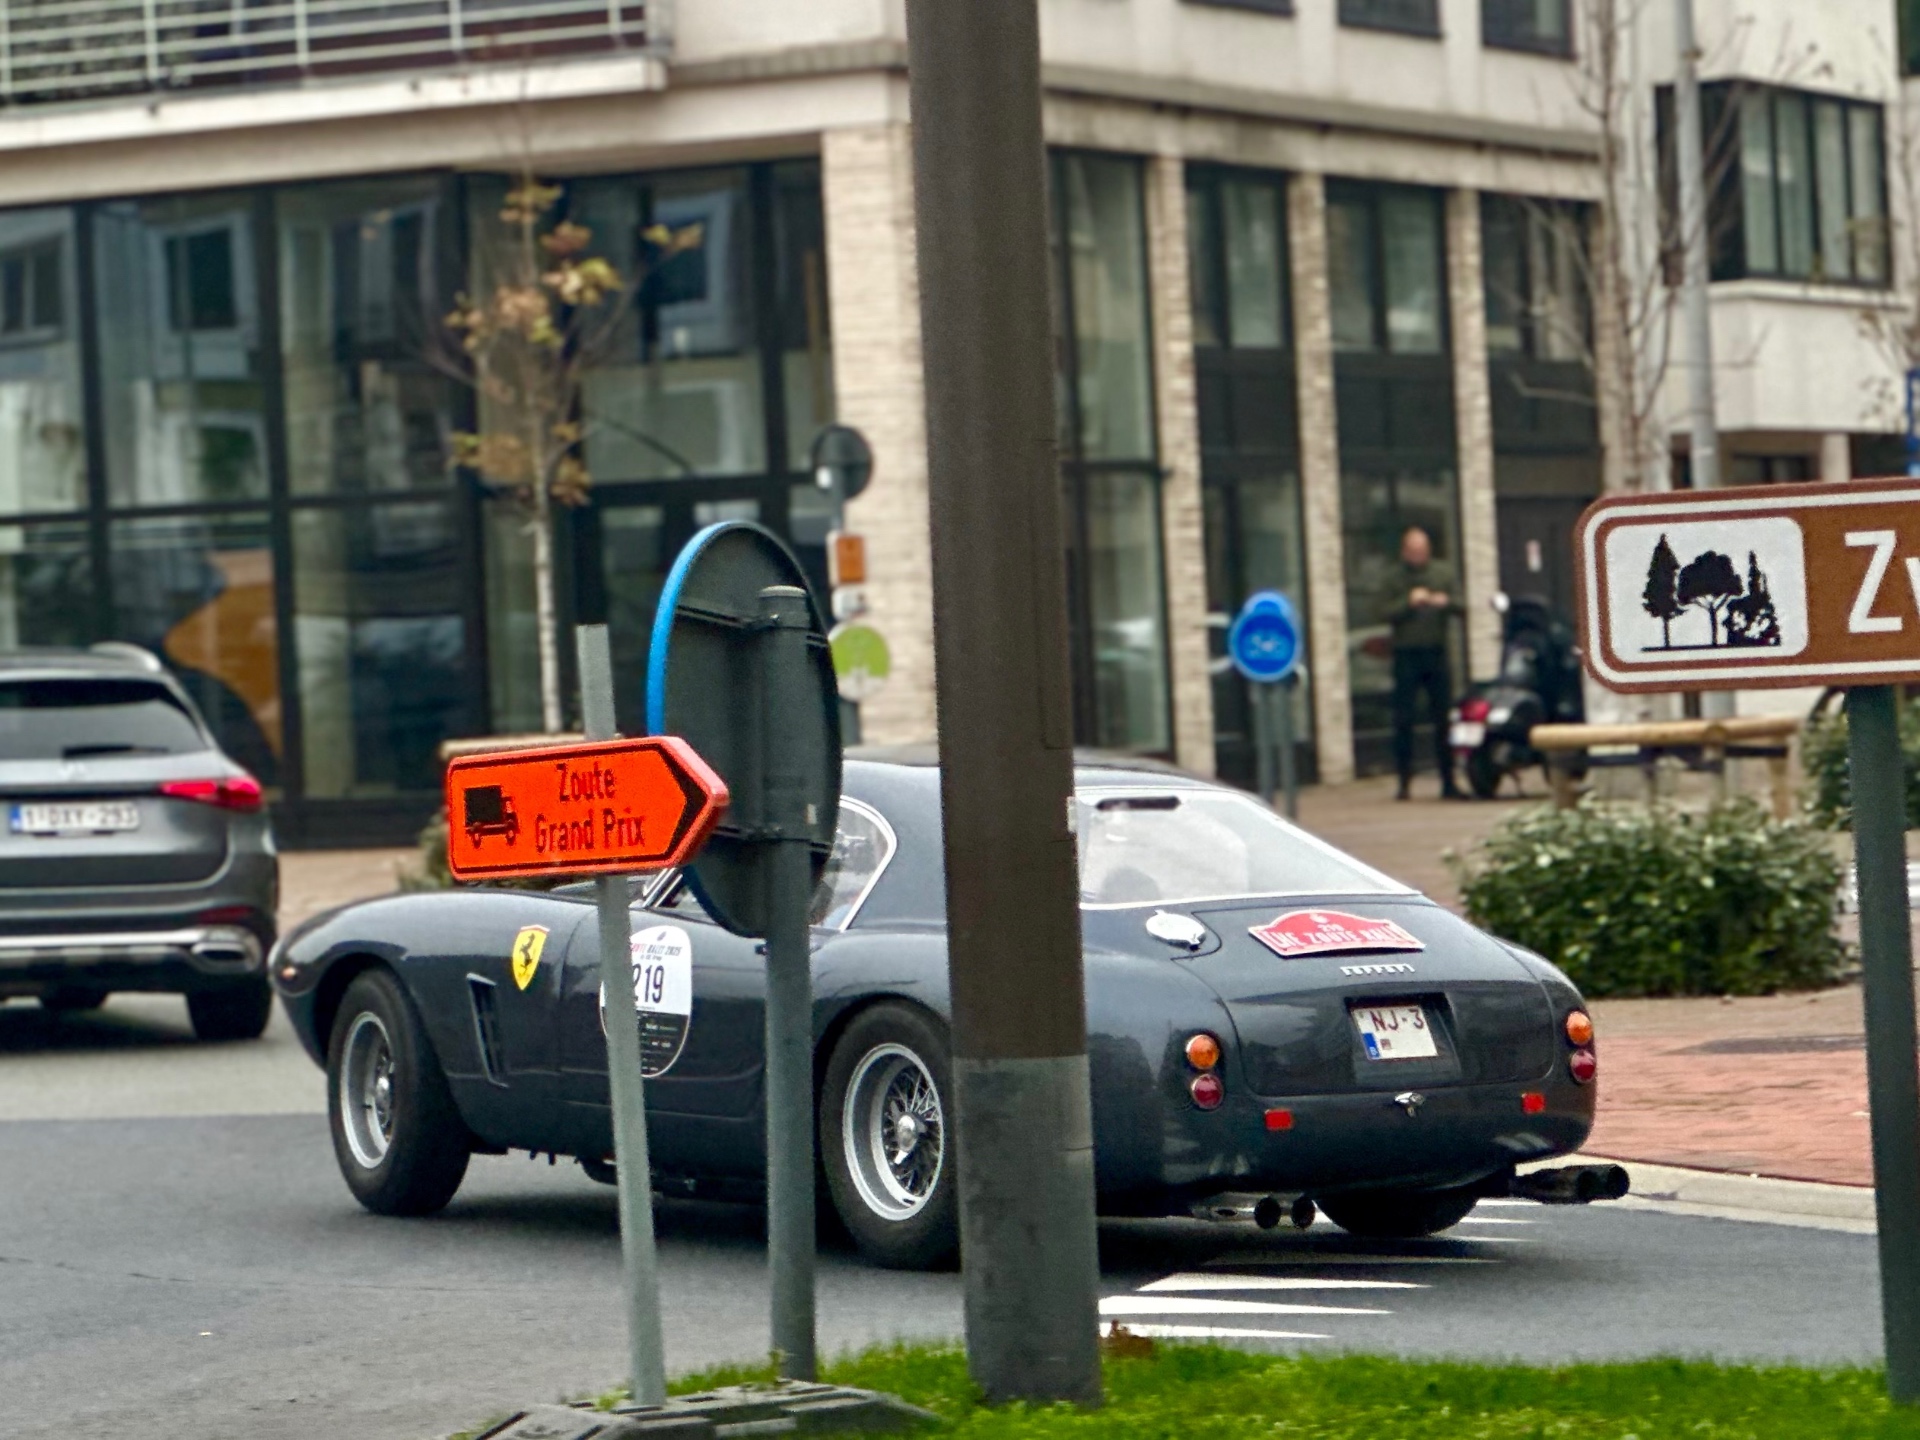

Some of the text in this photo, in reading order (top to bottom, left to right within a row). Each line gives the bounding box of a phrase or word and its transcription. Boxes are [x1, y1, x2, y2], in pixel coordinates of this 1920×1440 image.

[1844, 530, 1920, 633] Z
[556, 761, 616, 803] Zoute
[535, 806, 646, 853] Grand Prix
[1304, 930, 1362, 944] ZOUTE
[1369, 1008, 1424, 1030] NJ-3
